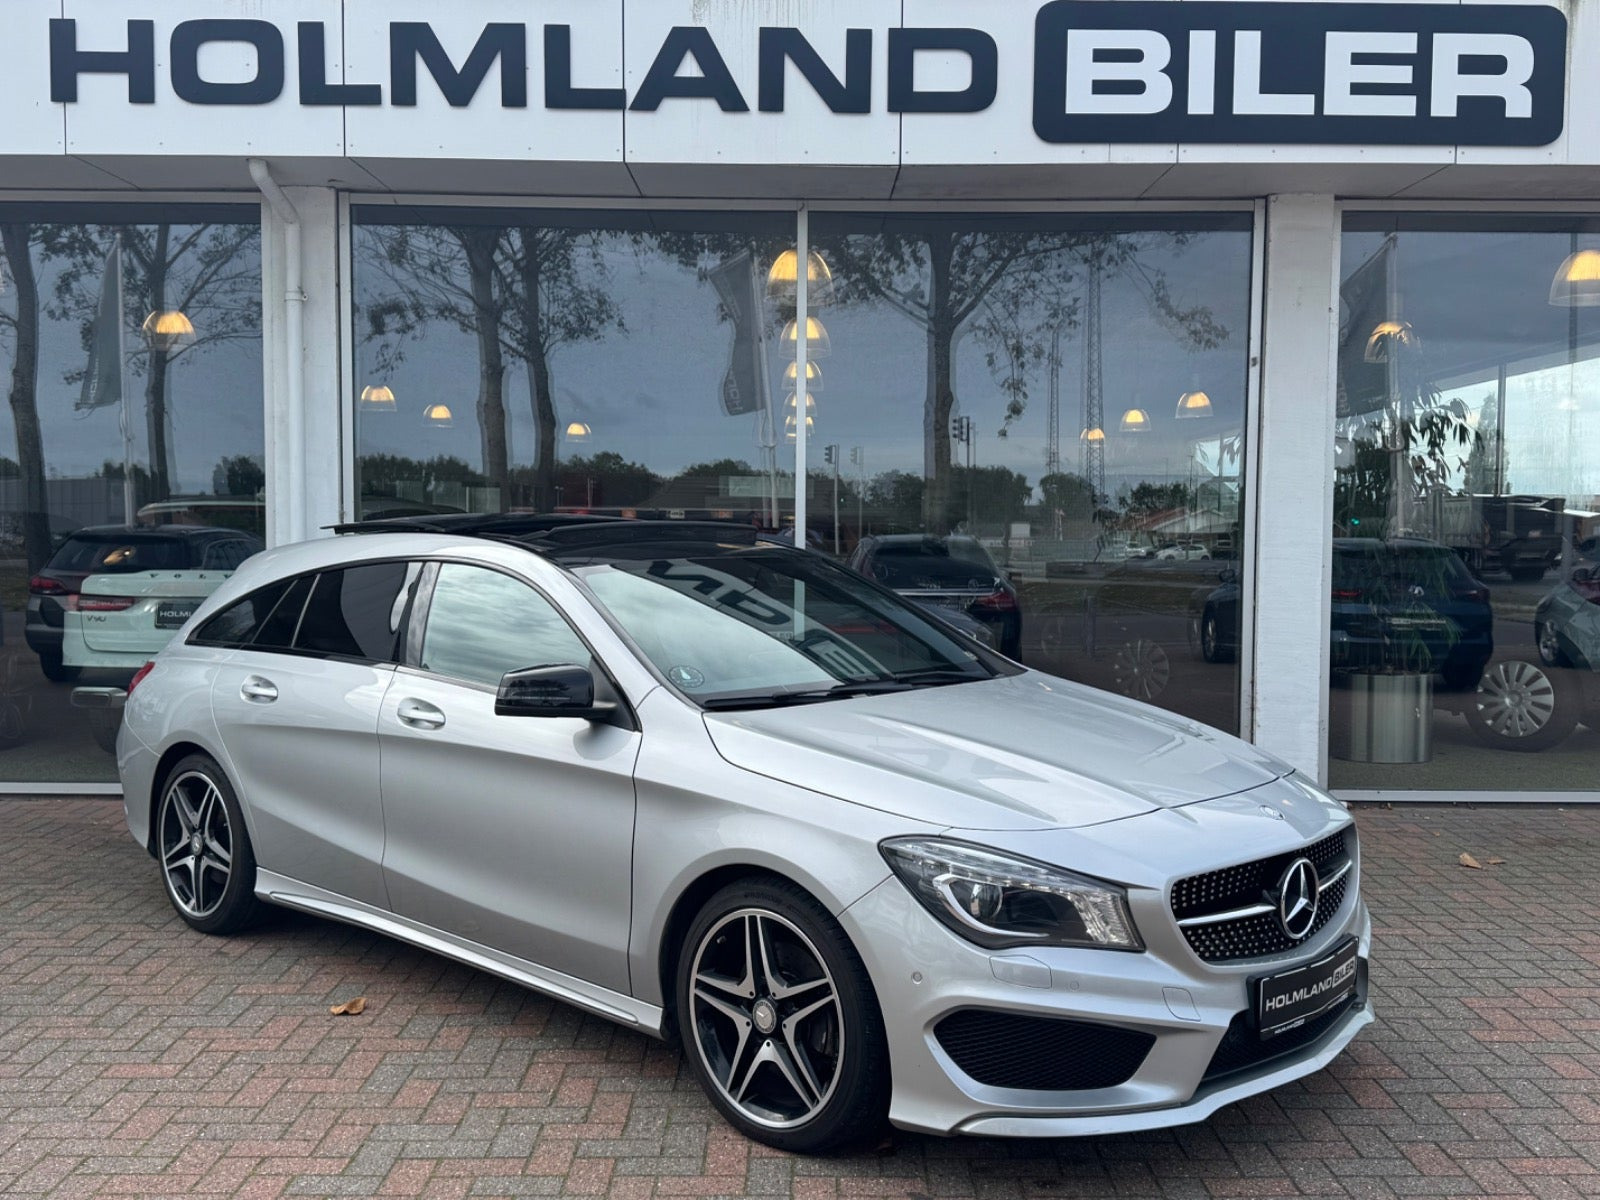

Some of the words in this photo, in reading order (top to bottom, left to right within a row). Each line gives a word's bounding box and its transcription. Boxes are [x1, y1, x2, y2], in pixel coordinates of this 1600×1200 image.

[50, 18, 998, 114] HOLMLAND
[1065, 29, 1536, 118] BILER
[1265, 976, 1333, 1012] HOLMLAND
[1334, 959, 1355, 983] BILER
